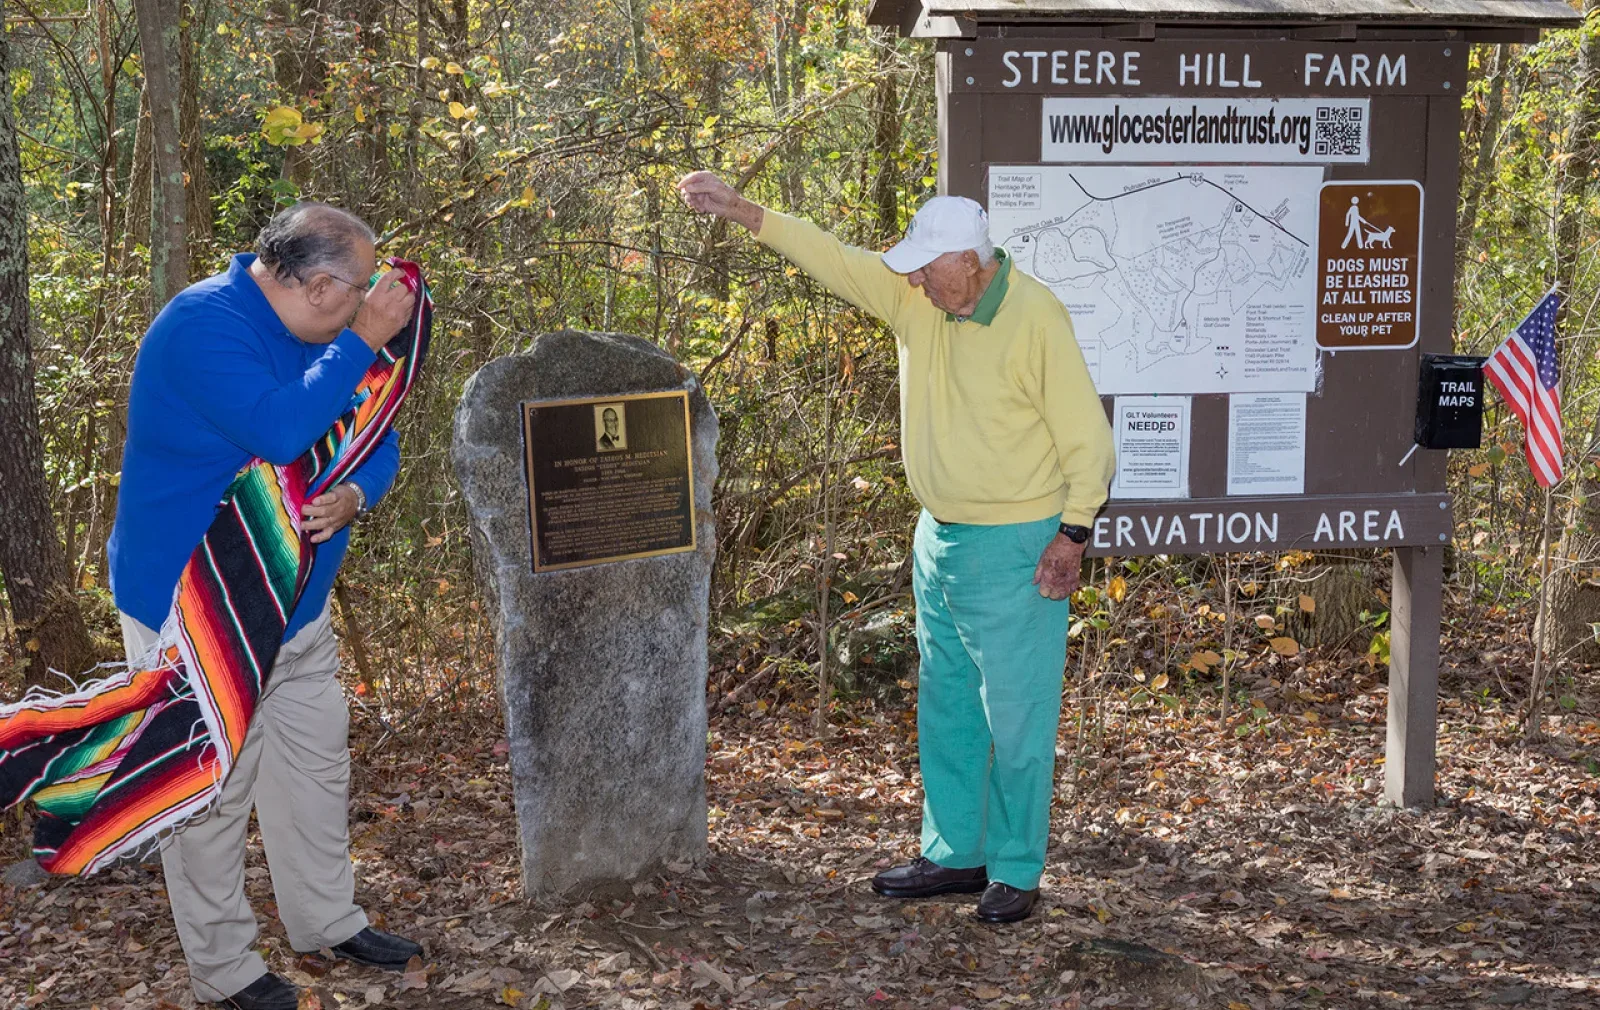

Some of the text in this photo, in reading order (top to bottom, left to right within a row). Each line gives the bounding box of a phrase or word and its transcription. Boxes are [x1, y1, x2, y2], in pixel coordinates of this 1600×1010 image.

[1002, 51, 1407, 88] STEERE HILL FARM
[1049, 105, 1311, 155] www.glocesterlandtrust.org
[1123, 177, 1161, 193] Putnam Pike
[1192, 175, 1203, 183] 44
[1013, 216, 1064, 234] Chestnut Oak Rd
[1327, 257, 1409, 273] DOGS MUST
[1326, 274, 1409, 289] BE LEASHED
[1322, 290, 1412, 305] AT ALL TIMES
[1321, 312, 1412, 323] CLEAN UP AFTER
[1339, 325, 1393, 336] YOUR PET
[1440, 381, 1476, 393] TRAIL
[1438, 396, 1475, 407] MAPS
[1142, 411, 1178, 419] Volunteers
[1128, 421, 1176, 431] NEEDED
[564, 458, 587, 467] HONOR
[1314, 509, 1405, 543] AREA
